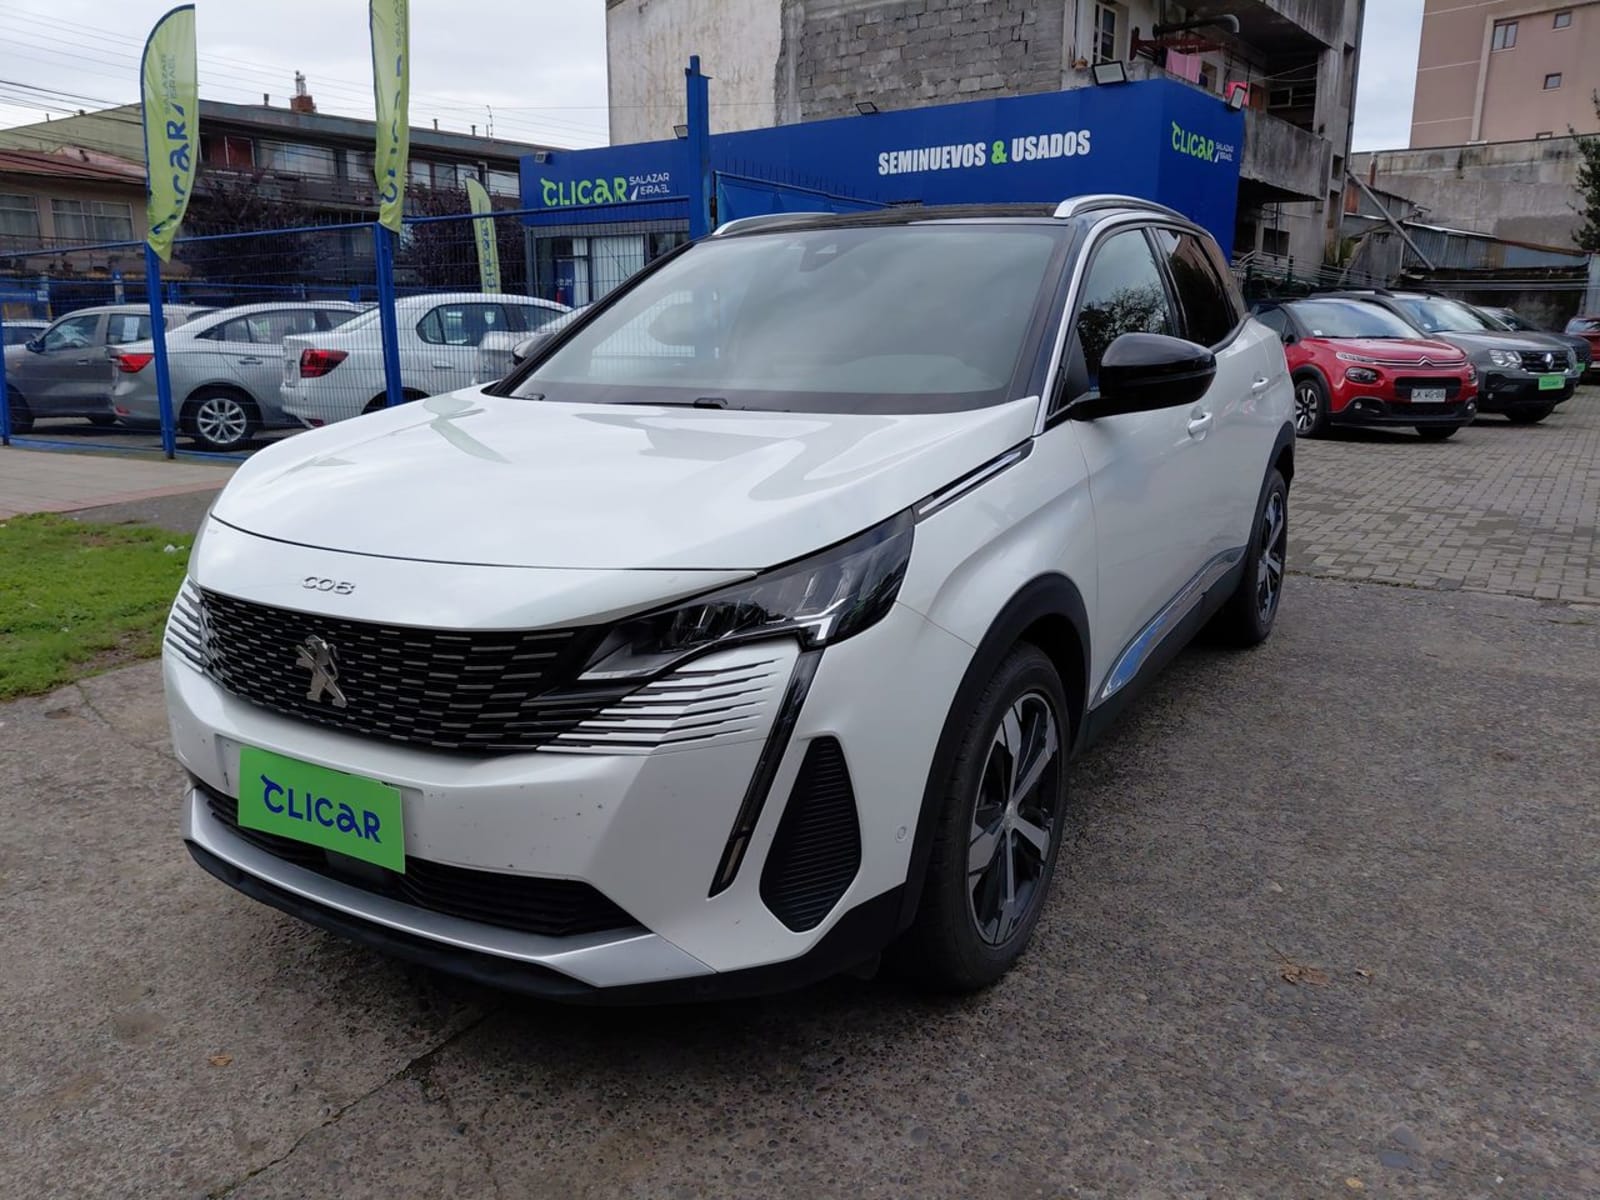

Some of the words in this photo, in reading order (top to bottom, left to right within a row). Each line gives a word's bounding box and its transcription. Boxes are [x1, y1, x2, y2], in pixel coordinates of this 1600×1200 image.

[878, 142, 986, 176] SEMINUEVOS
[991, 140, 1008, 165] &
[1011, 130, 1092, 163] USADOS
[629, 172, 670, 186] SALAZAR
